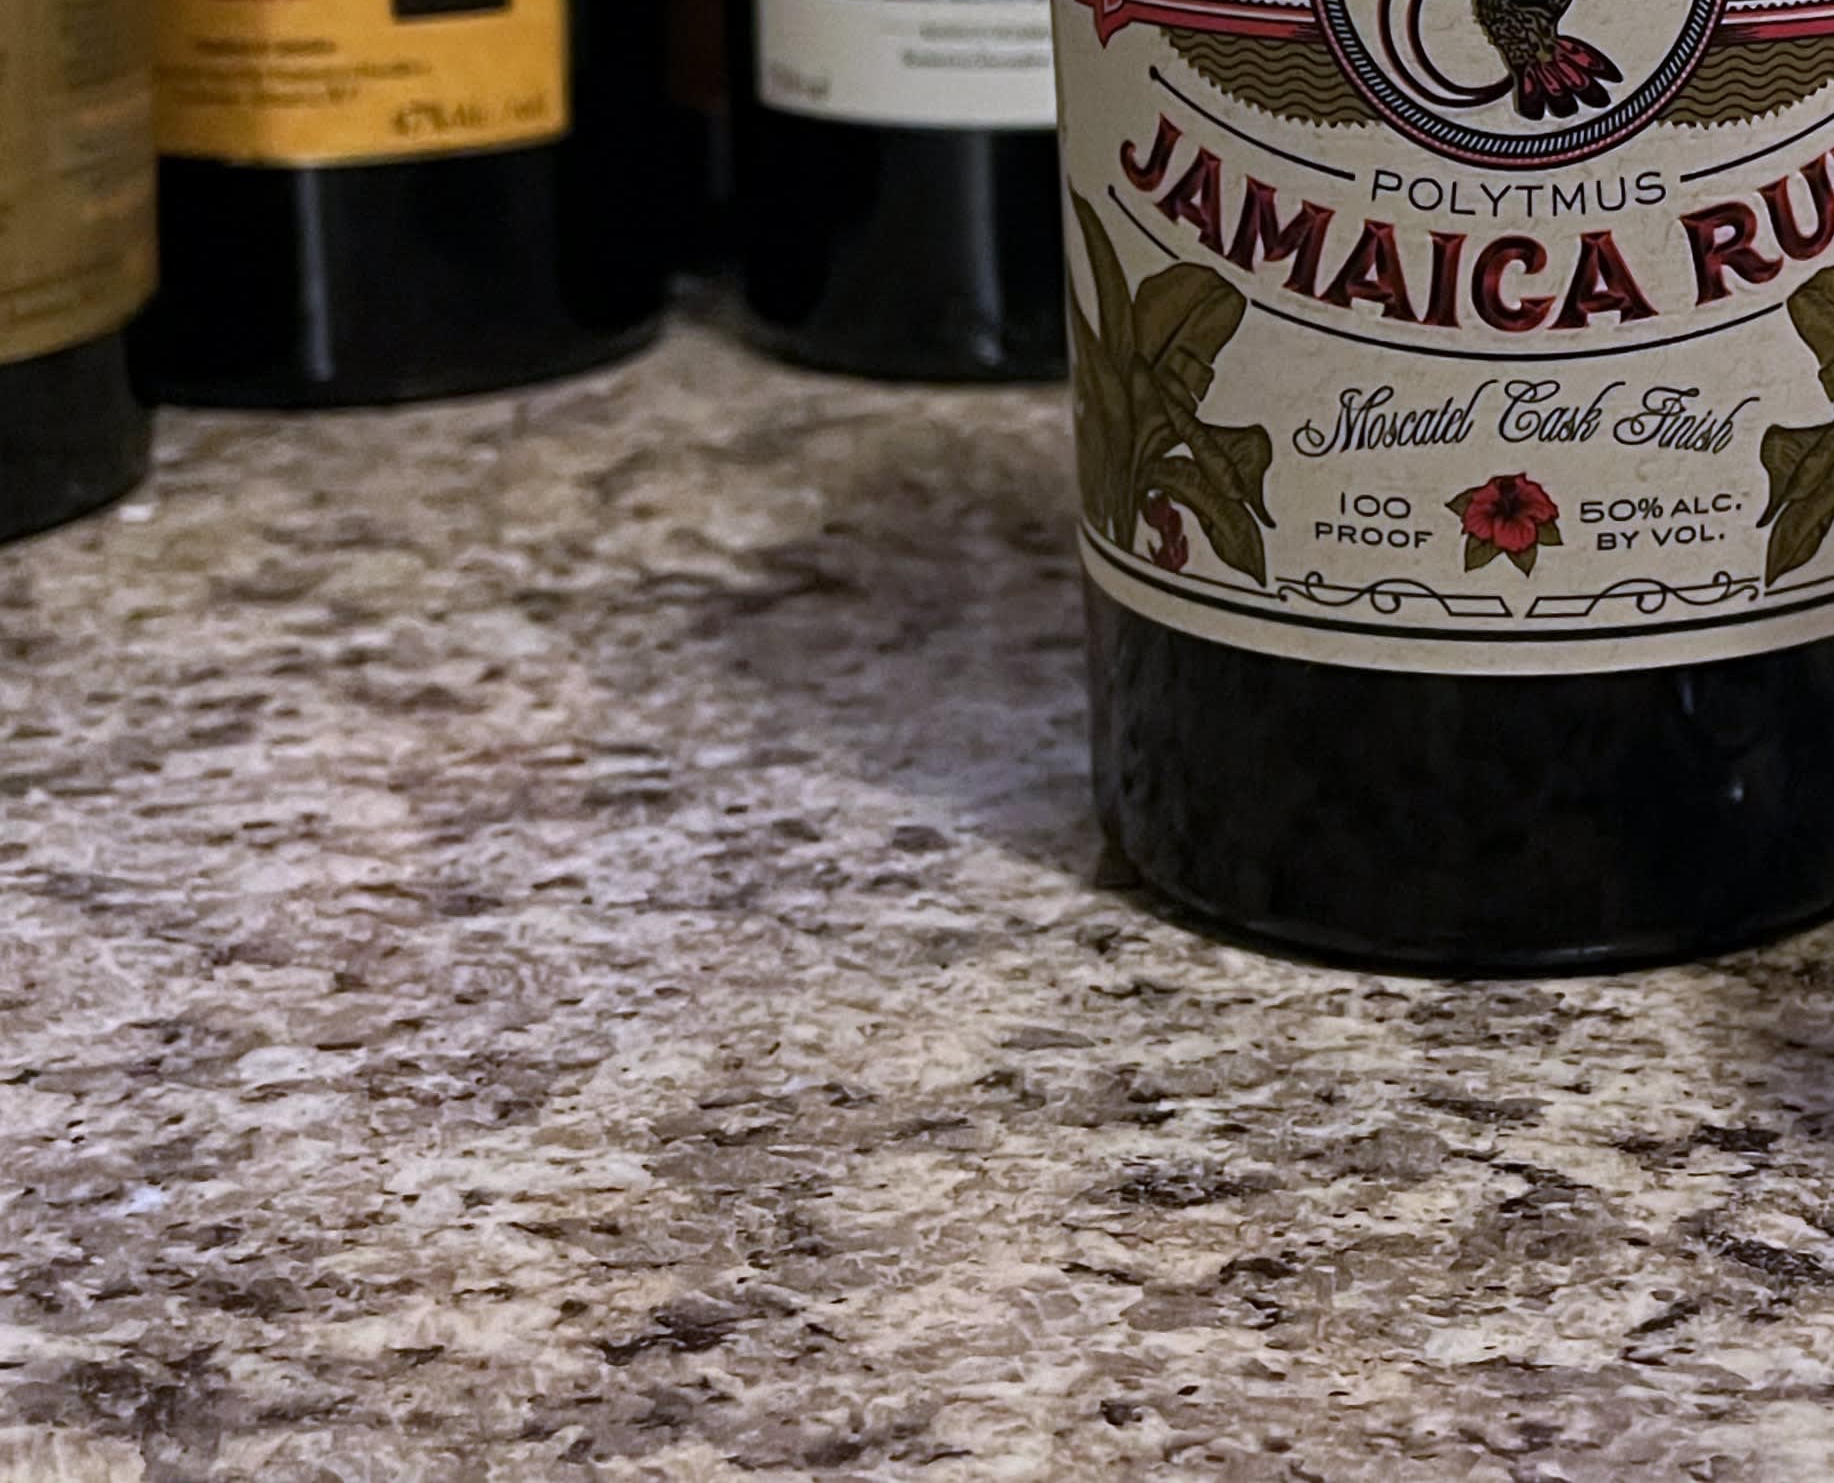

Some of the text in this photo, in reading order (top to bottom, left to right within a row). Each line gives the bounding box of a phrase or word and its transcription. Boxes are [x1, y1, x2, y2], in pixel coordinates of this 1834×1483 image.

[1370, 169, 1668, 218] POLYTMUS
[1119, 112, 1662, 334] JAMAICA
[1292, 378, 1762, 458] Moscatel Cask Finish
[1339, 492, 1412, 518] 100
[1579, 491, 1743, 524] 50% ALC.
[1314, 521, 1434, 549] PROOF
[1596, 524, 1726, 551] BY VOL.
